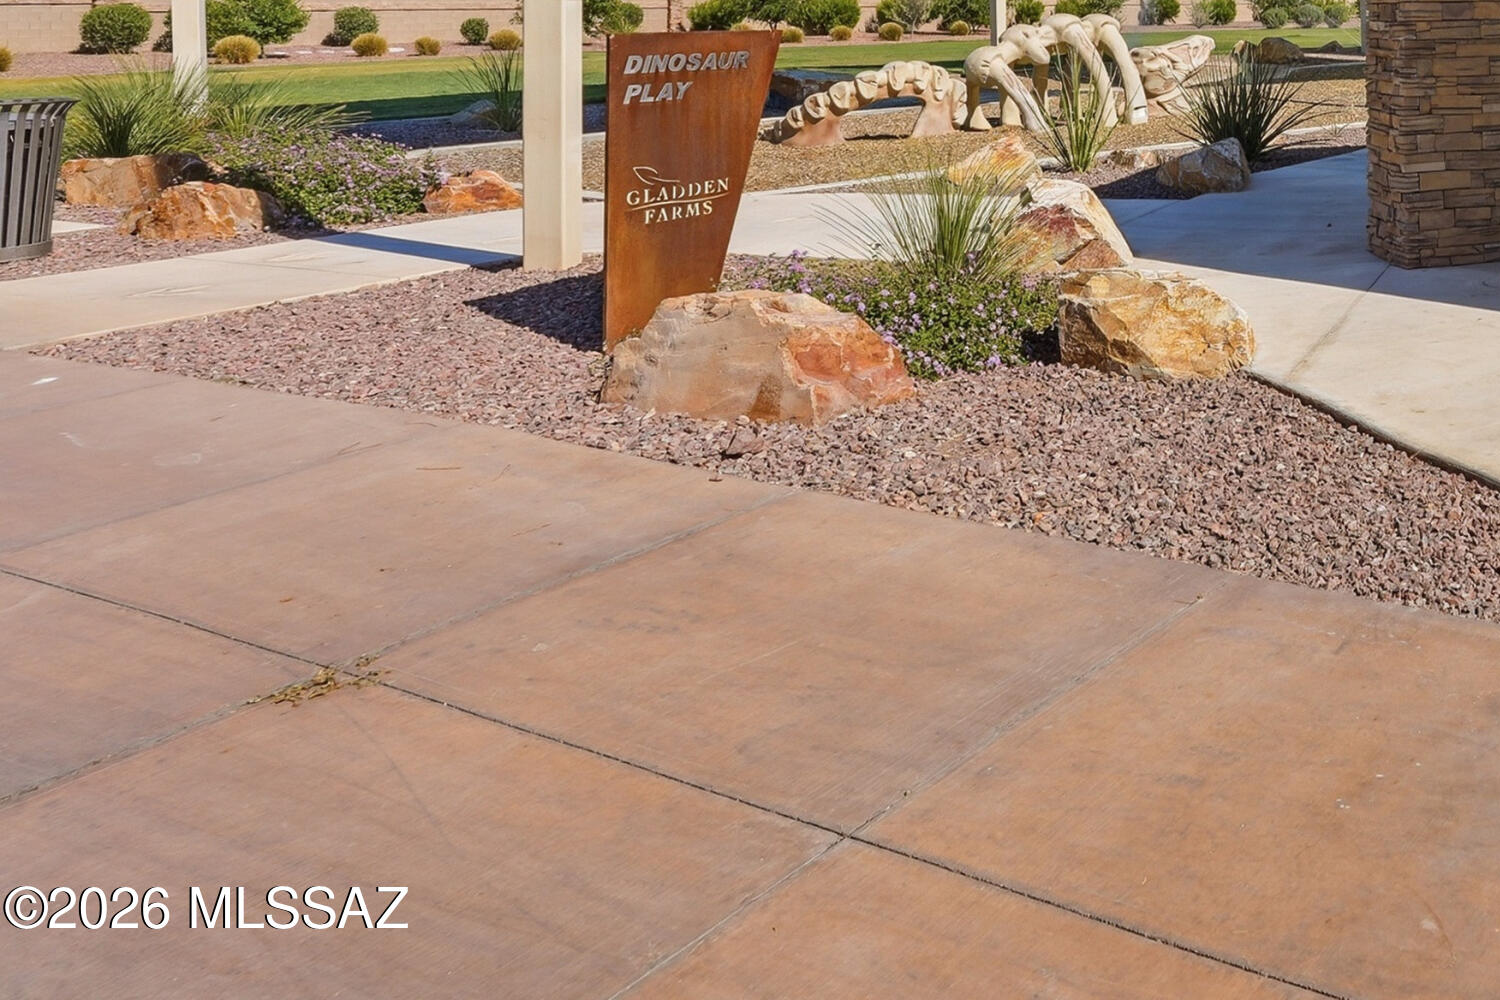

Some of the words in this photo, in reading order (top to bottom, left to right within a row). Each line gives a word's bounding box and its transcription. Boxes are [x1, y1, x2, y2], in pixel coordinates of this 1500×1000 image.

[623, 50, 751, 75] DINOSAUR
[622, 81, 694, 105] PLAY
[626, 177, 729, 206] GLADDEN
[644, 200, 713, 225] FARMS
